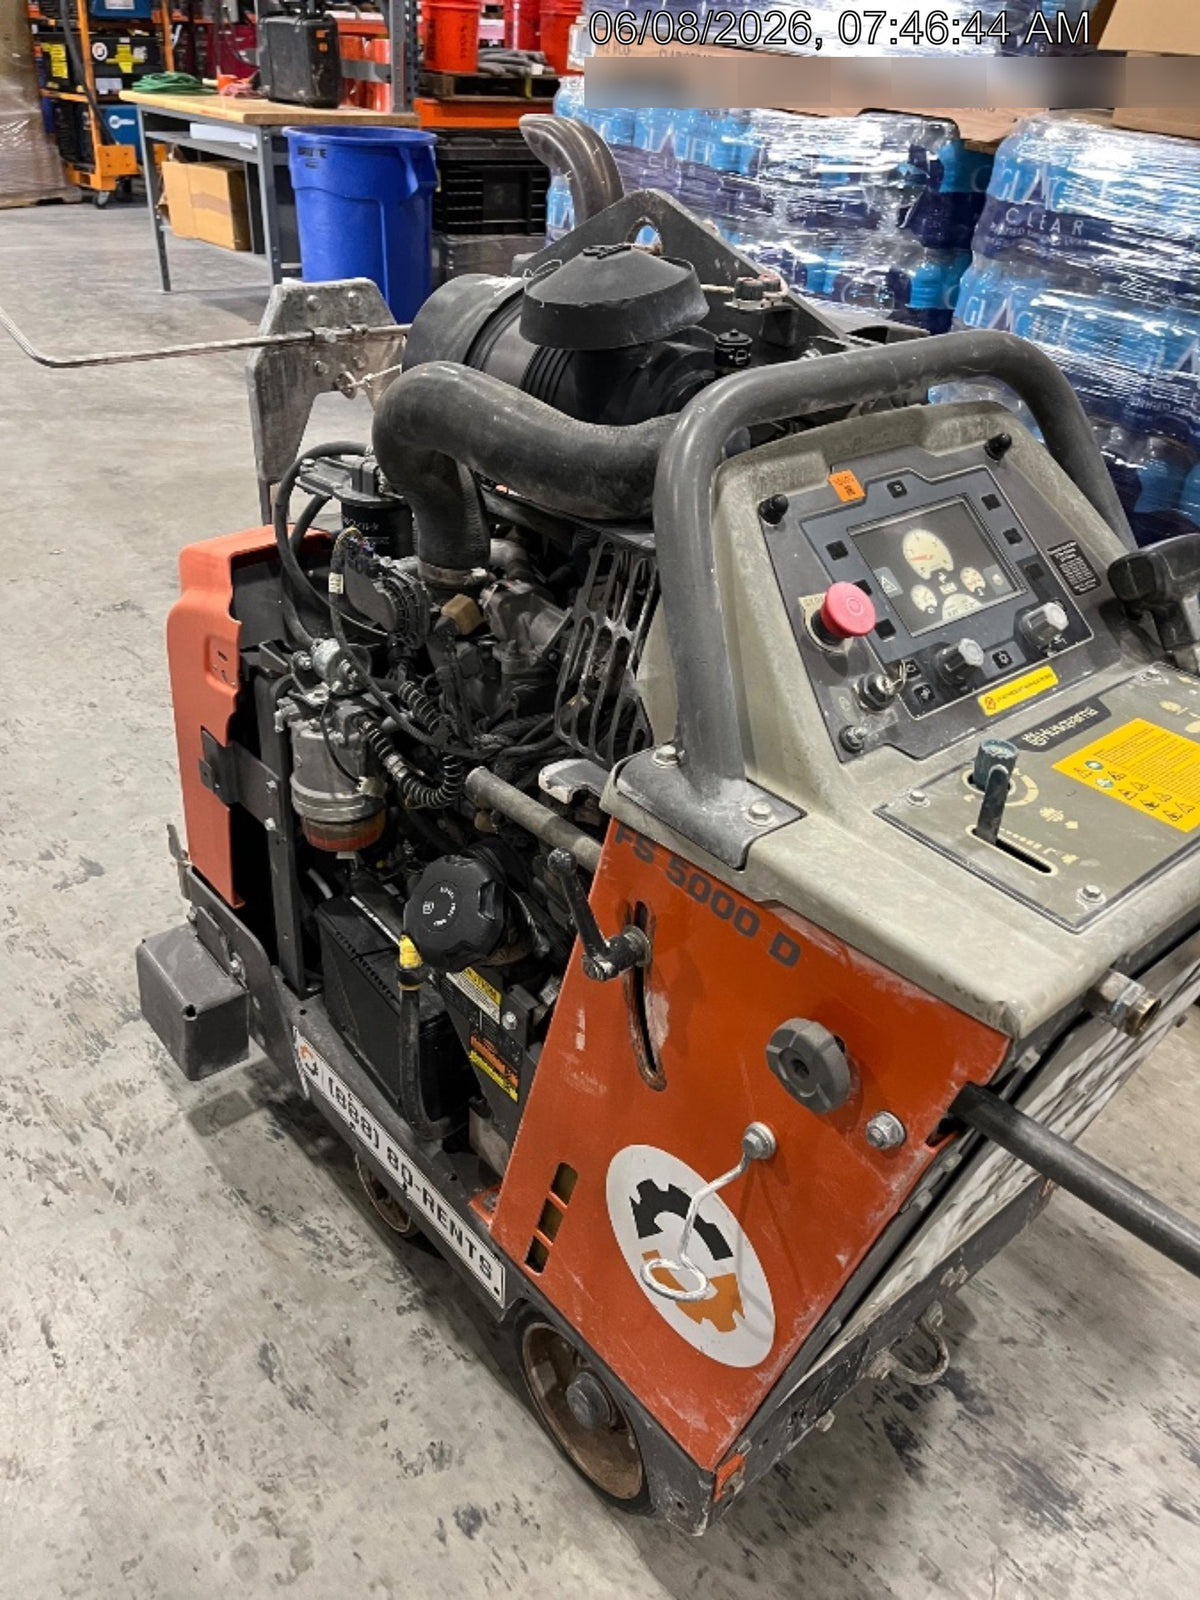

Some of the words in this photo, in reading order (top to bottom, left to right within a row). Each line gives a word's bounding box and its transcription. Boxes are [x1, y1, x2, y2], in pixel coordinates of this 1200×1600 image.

[1005, 207, 1084, 236] CLEAR
[613, 823, 656, 866] FS
[664, 855, 761, 939] 5000
[768, 931, 801, 968] D
[386, 1148, 494, 1281] 80-RENTS
